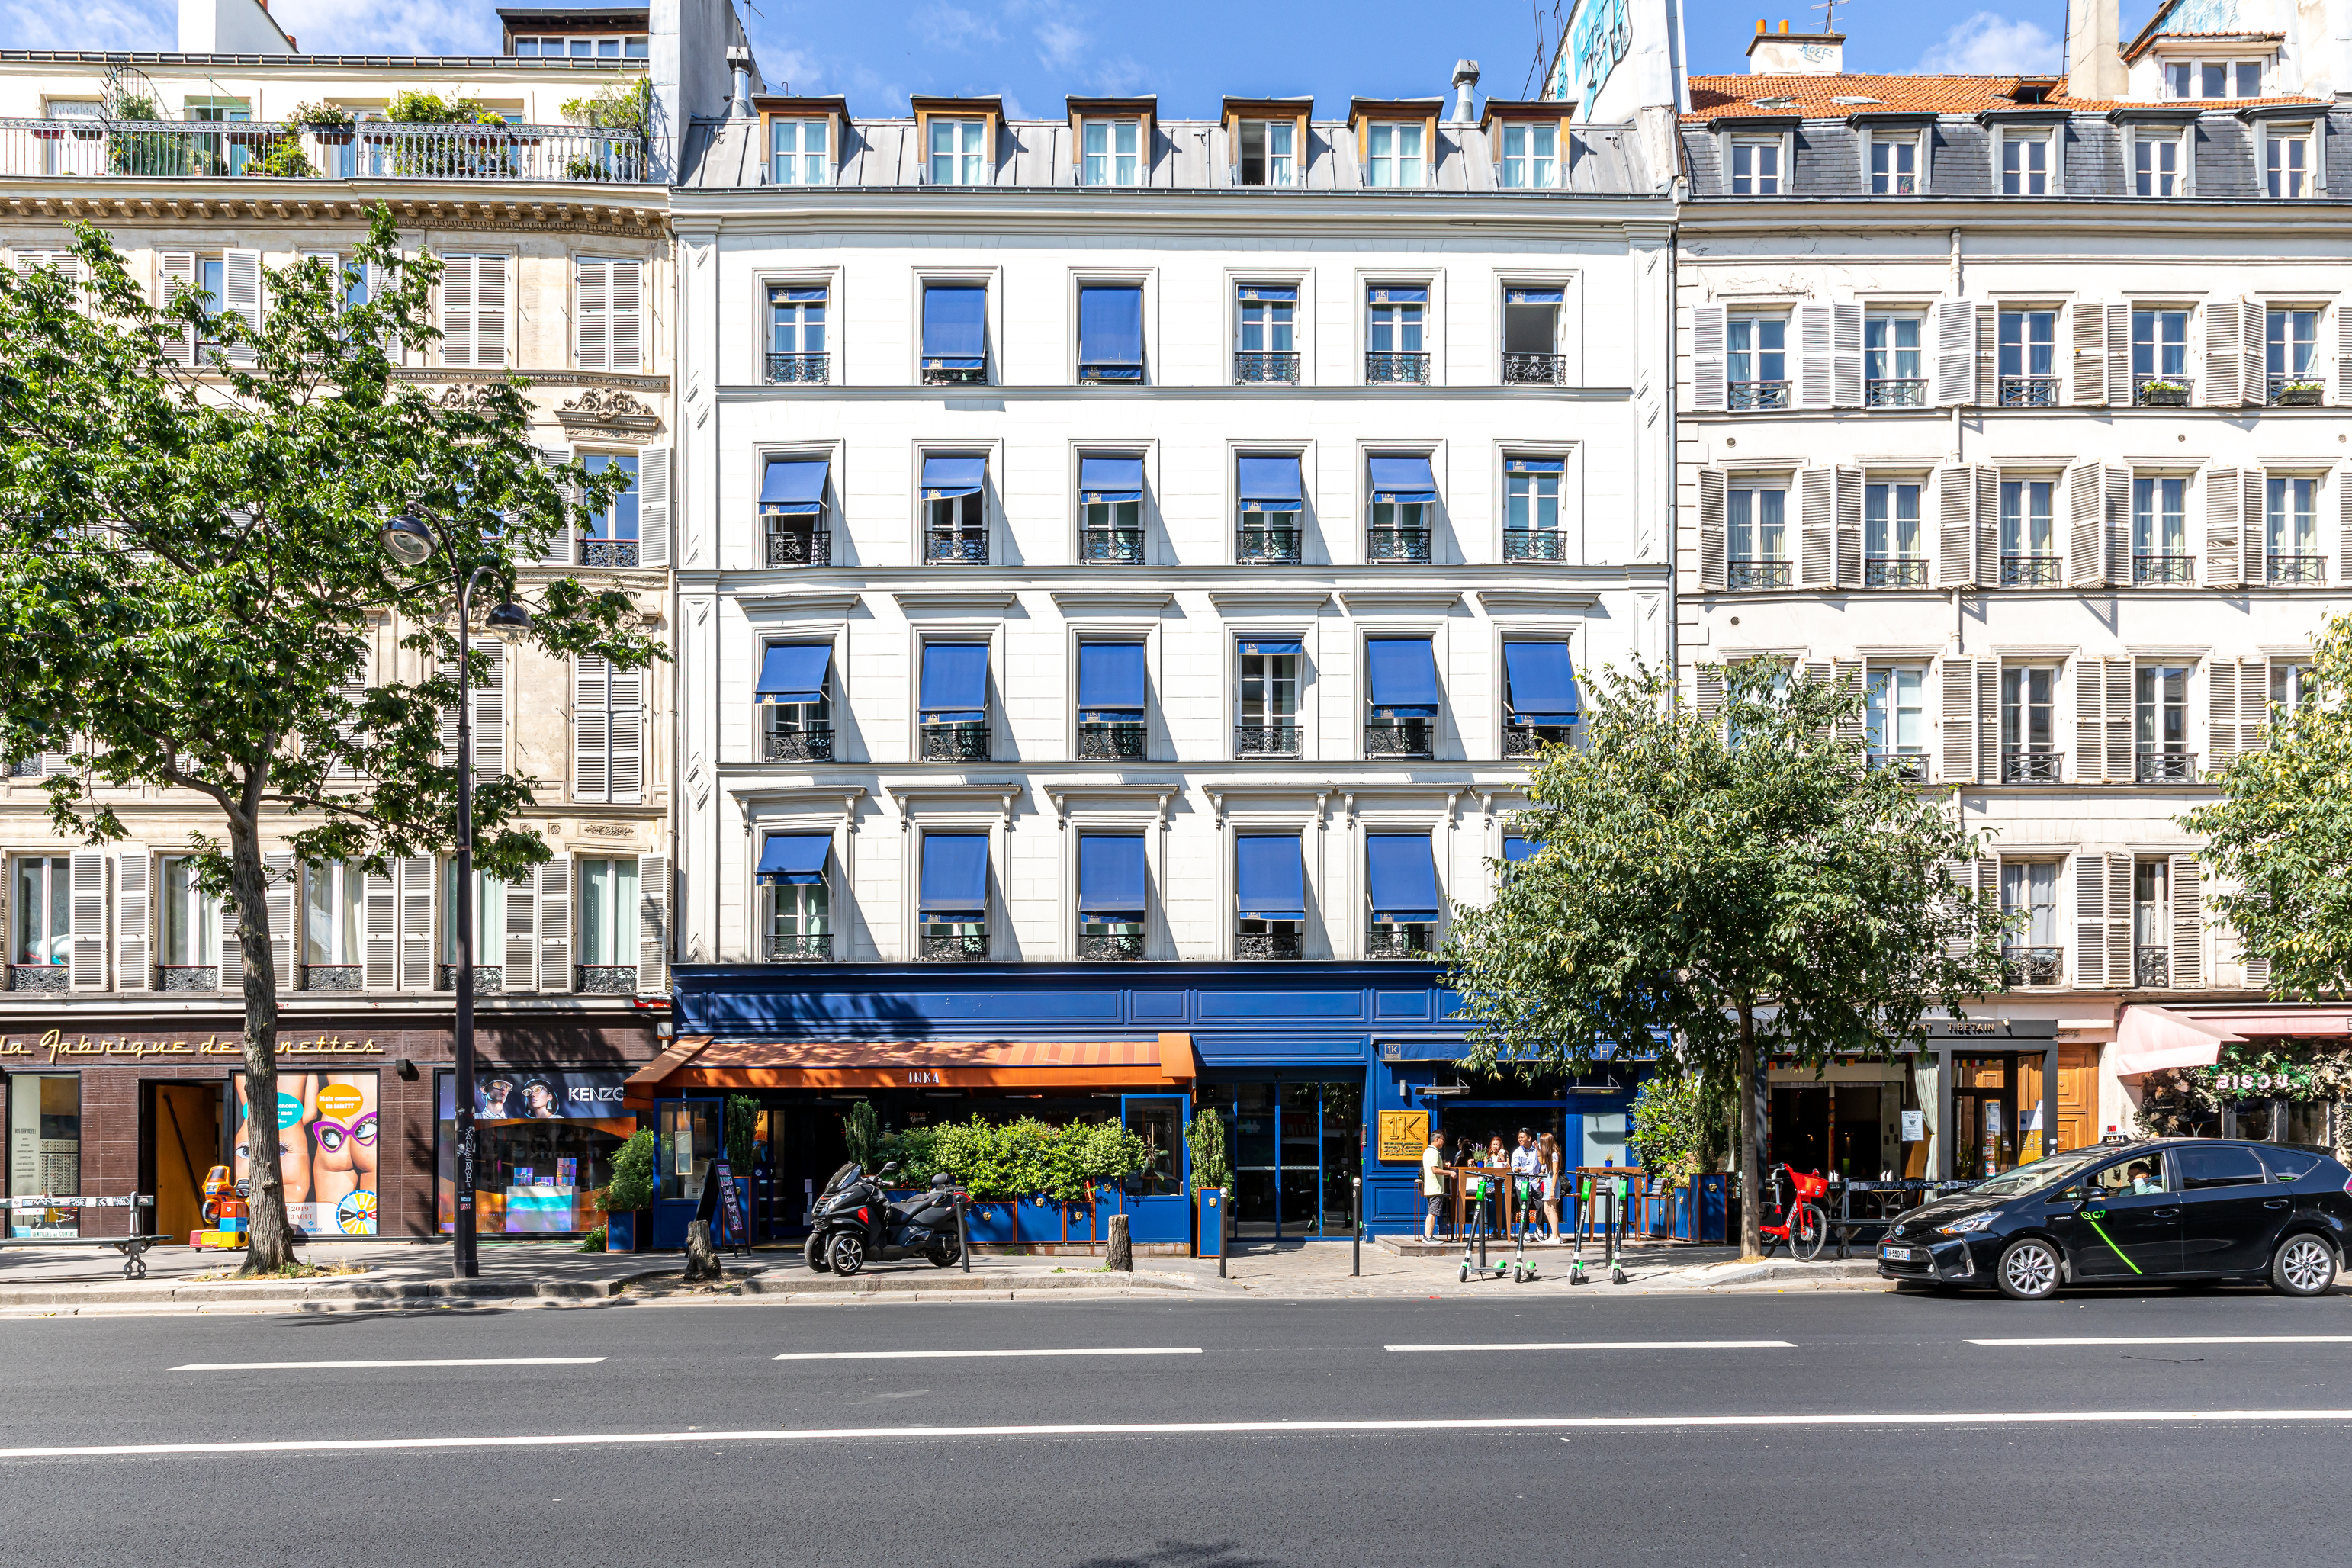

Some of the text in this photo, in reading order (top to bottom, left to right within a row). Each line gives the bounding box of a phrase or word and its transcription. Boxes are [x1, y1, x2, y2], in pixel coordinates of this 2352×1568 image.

[1947, 1023, 1994, 1031] TIBETAIN
[39, 1029, 194, 1063] Fabrique
[199, 1034, 241, 1053] de
[275, 1036, 384, 1053] nettes
[908, 1071, 940, 1084] INKA
[1388, 1116, 1421, 1140] 1K
[2092, 1210, 2106, 1219] G7
